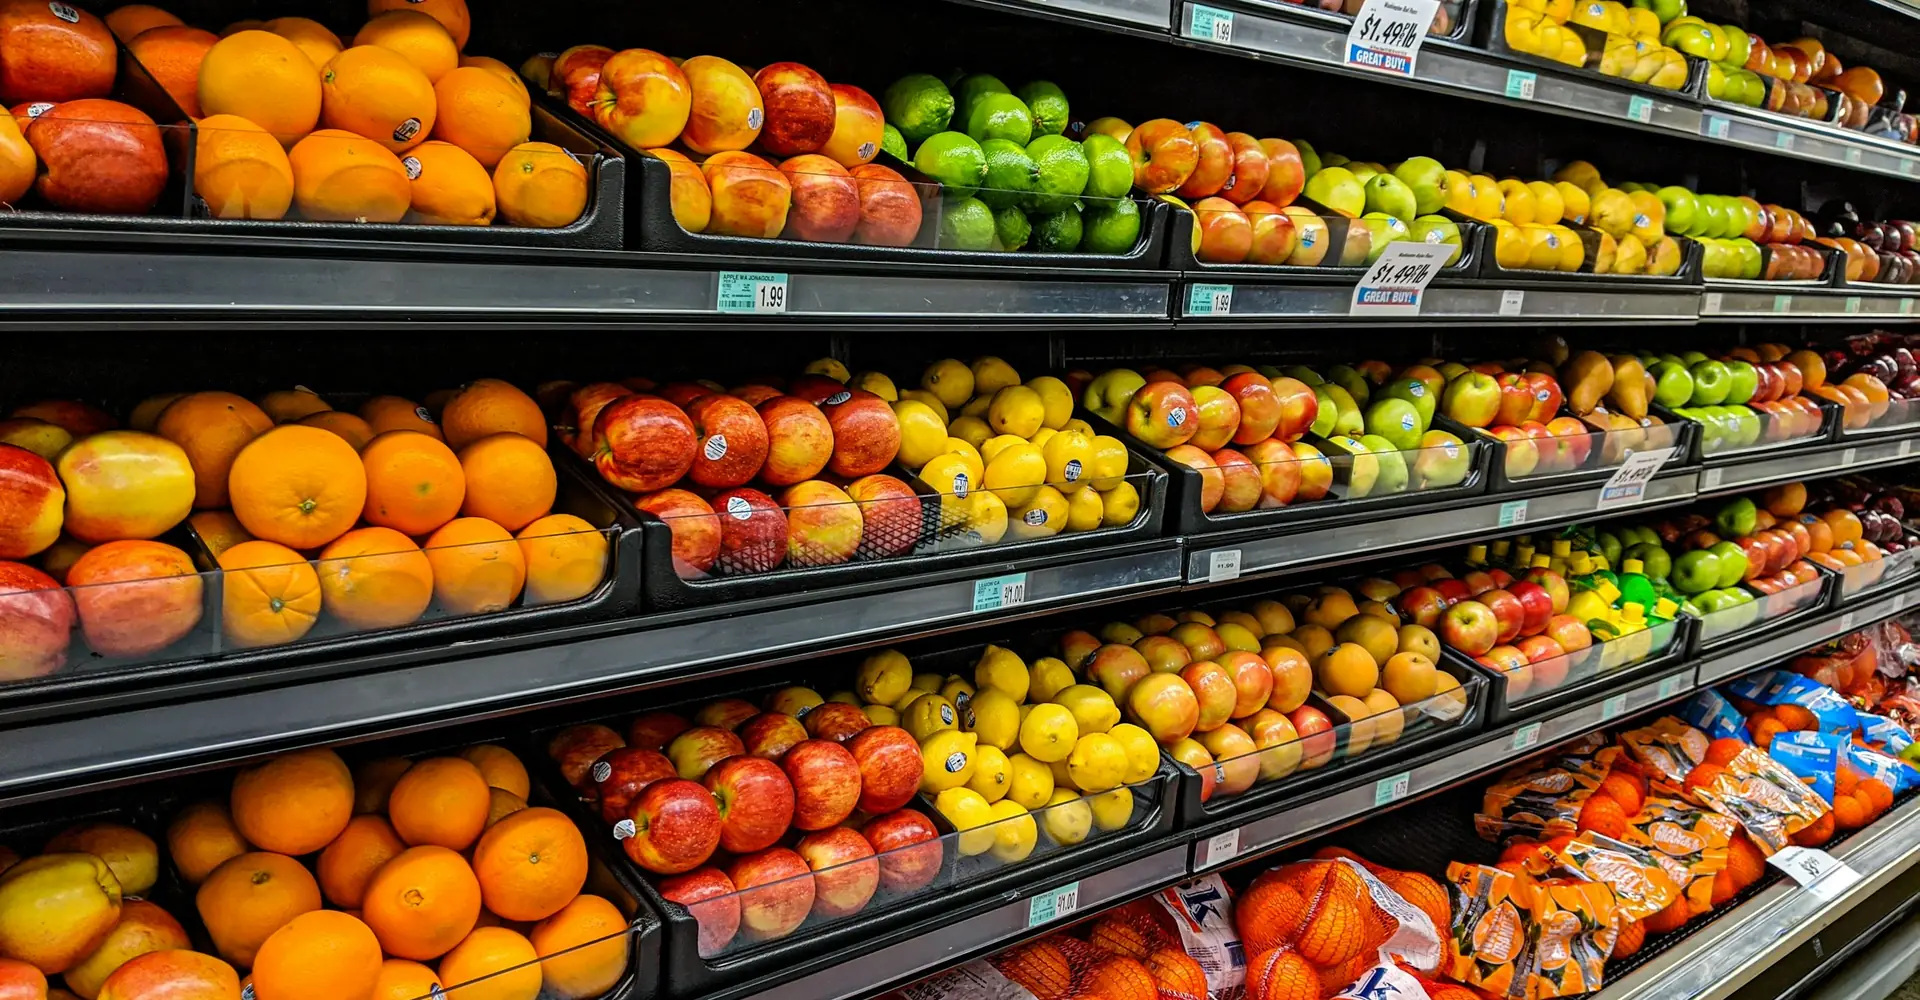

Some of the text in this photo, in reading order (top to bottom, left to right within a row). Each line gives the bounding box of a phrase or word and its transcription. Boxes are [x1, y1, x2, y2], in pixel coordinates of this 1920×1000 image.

[1216, 22, 1230, 41] 1.99
[1360, 13, 1403, 45] $1.49
[1356, 49, 1385, 67] GREAT
[1385, 55, 1407, 71] BUY!
[1371, 262, 1416, 284] $1.49
[761, 285, 783, 307] 1.99
[1216, 294, 1229, 311] 1.99
[1363, 290, 1413, 304] GREAT BUY!
